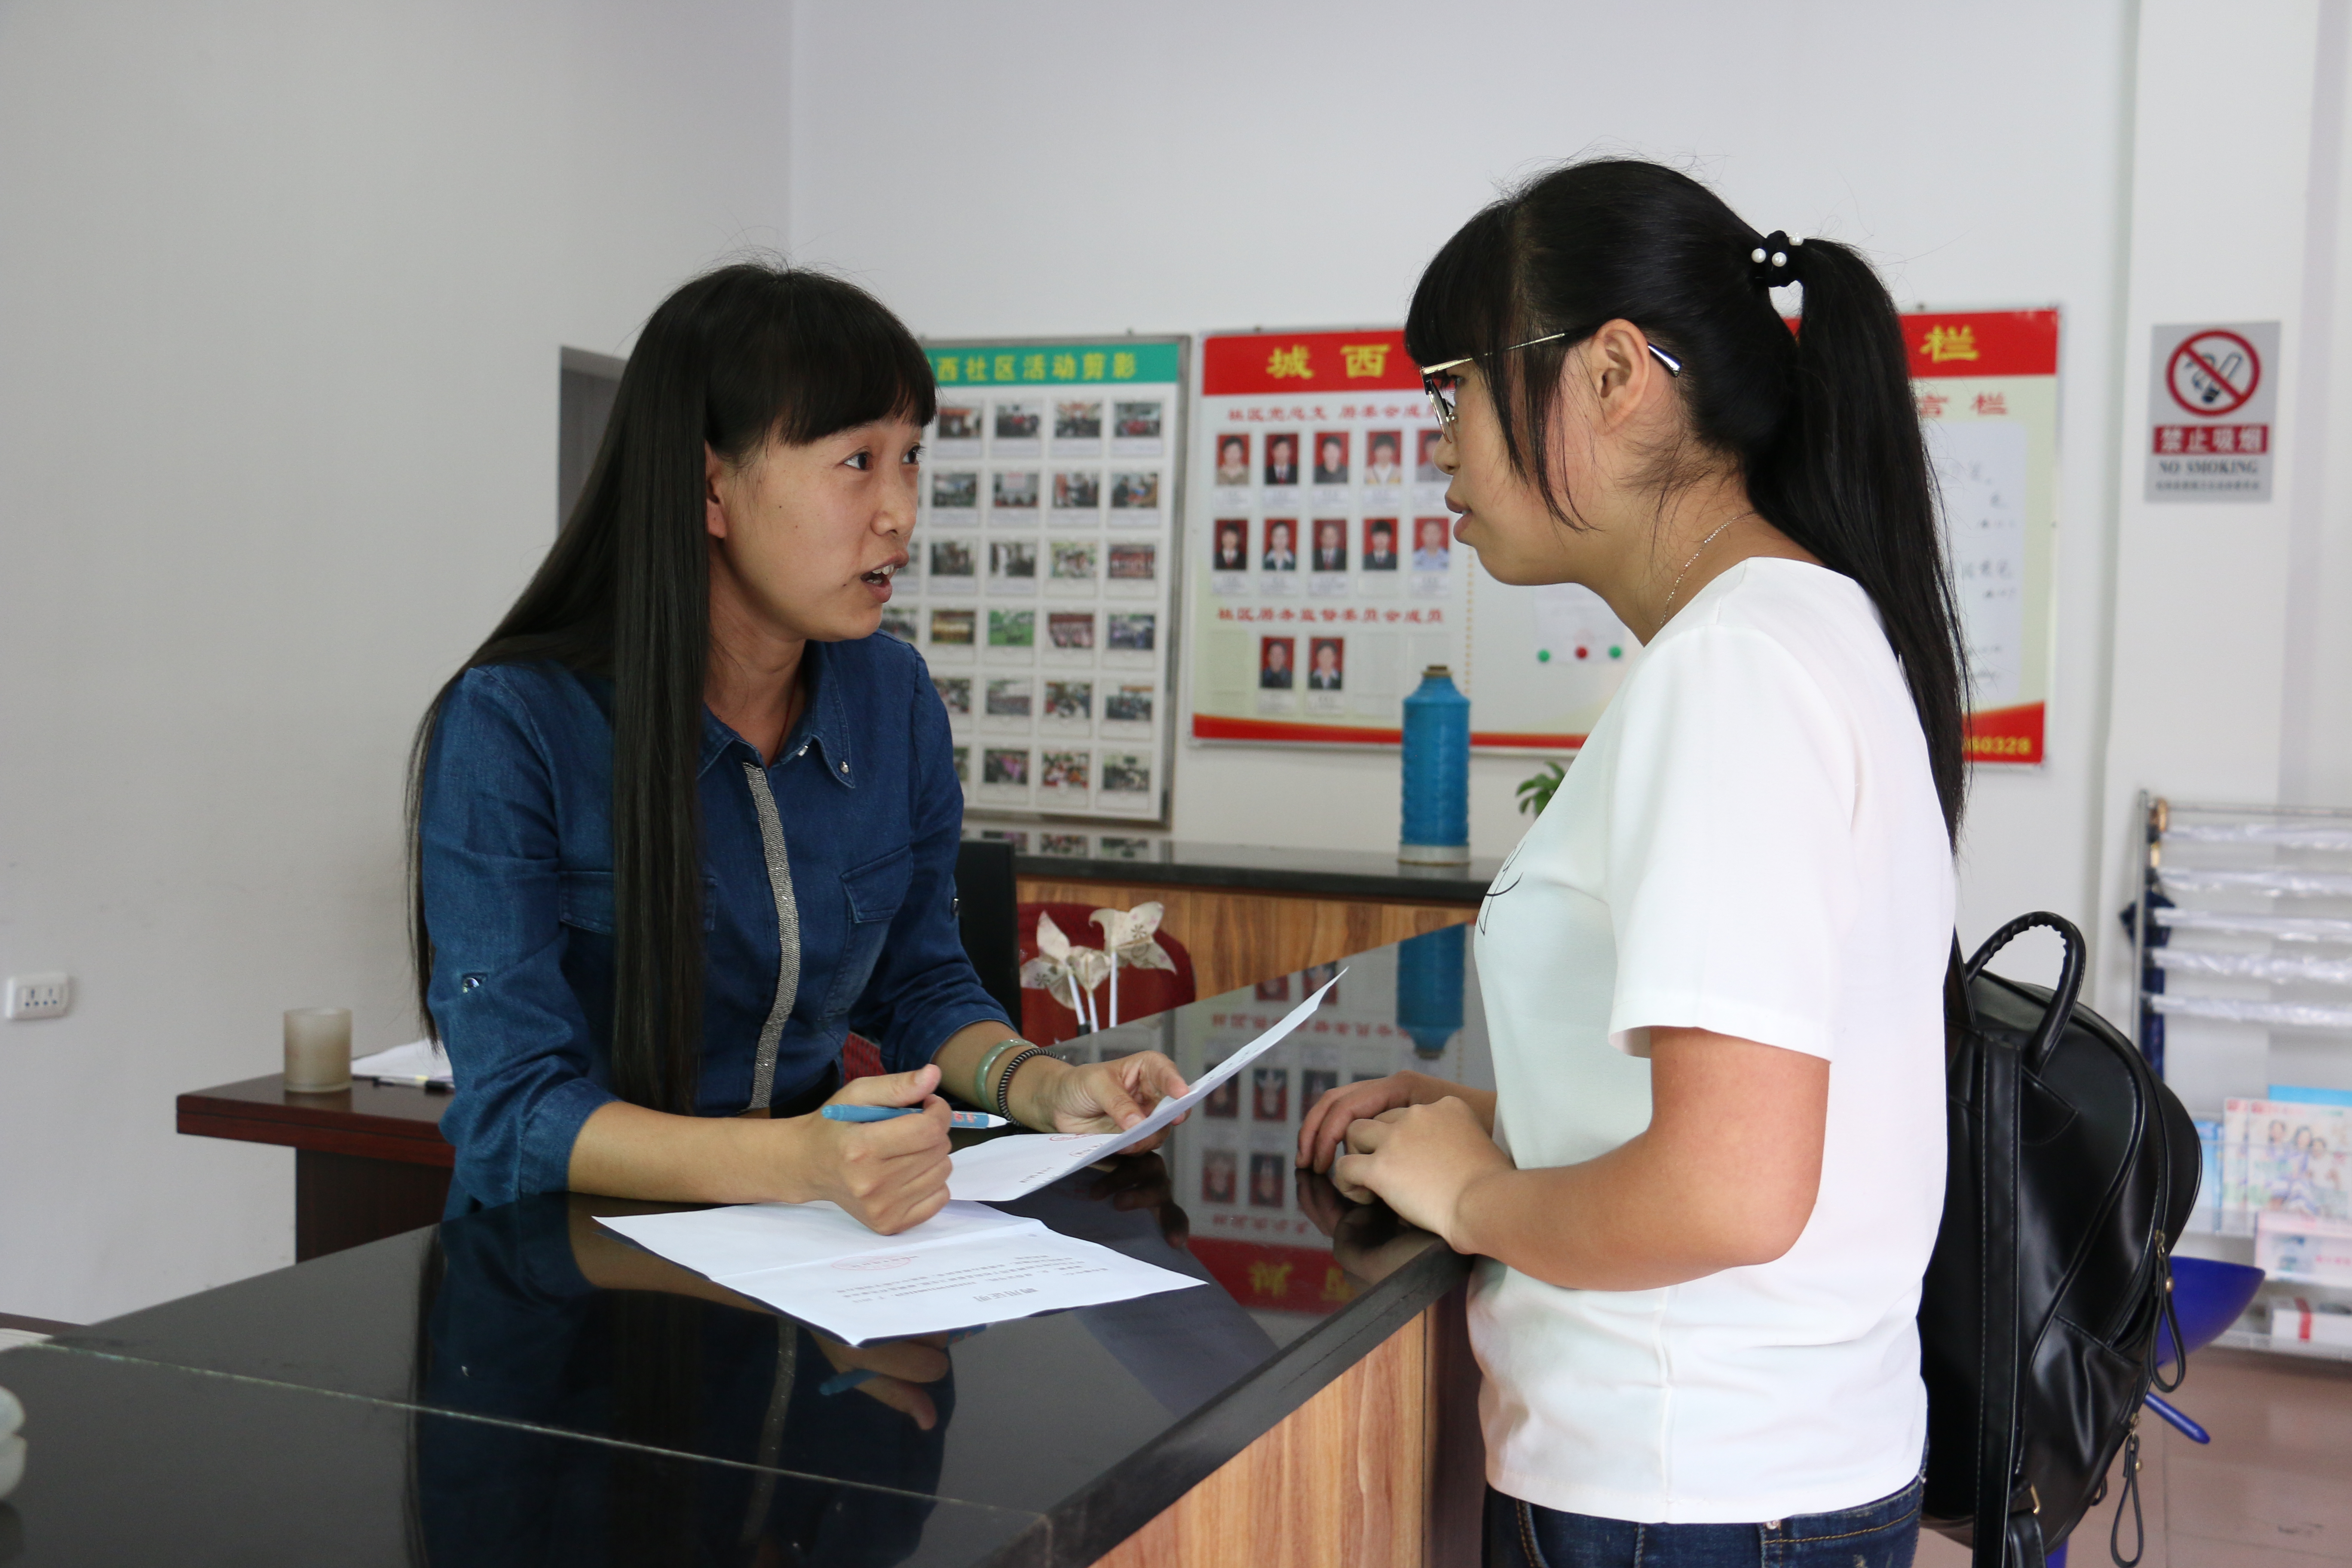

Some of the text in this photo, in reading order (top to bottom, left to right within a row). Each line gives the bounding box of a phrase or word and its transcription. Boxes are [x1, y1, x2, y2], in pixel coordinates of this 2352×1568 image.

[927, 352, 1136, 382] 西社区活动剪影
[1265, 343, 1392, 379] 城西
[2159, 460, 2258, 473] NO SMOKING
